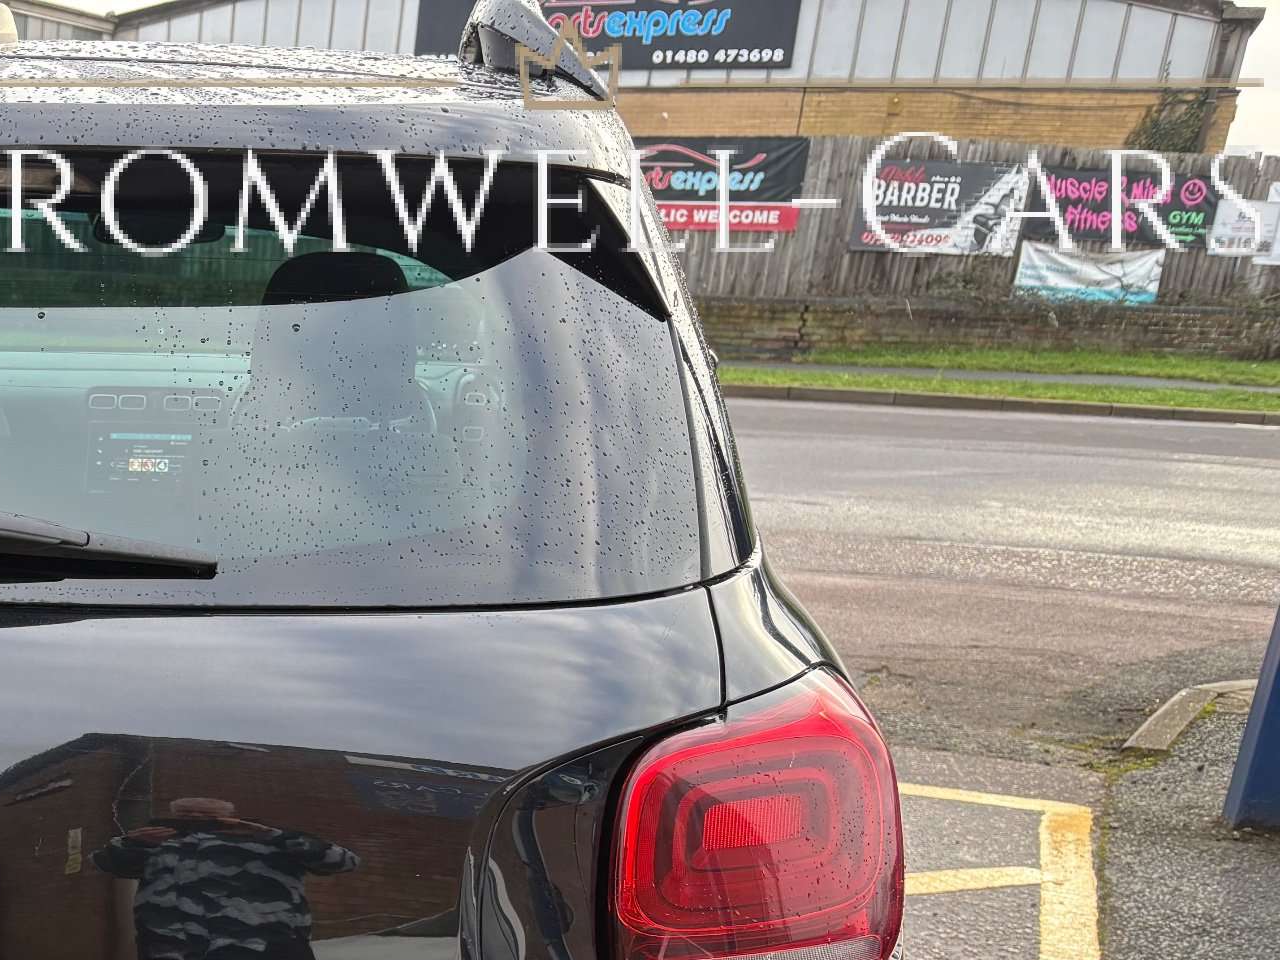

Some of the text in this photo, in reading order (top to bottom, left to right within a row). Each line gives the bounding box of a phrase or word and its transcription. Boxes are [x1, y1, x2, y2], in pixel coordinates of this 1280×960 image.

[652, 48, 784, 63] 01480 473698
[871, 177, 961, 210] BARBER
[693, 208, 781, 224] WECOME
[1065, 203, 1138, 232] Fitnes
[1168, 210, 1206, 225] GYM
